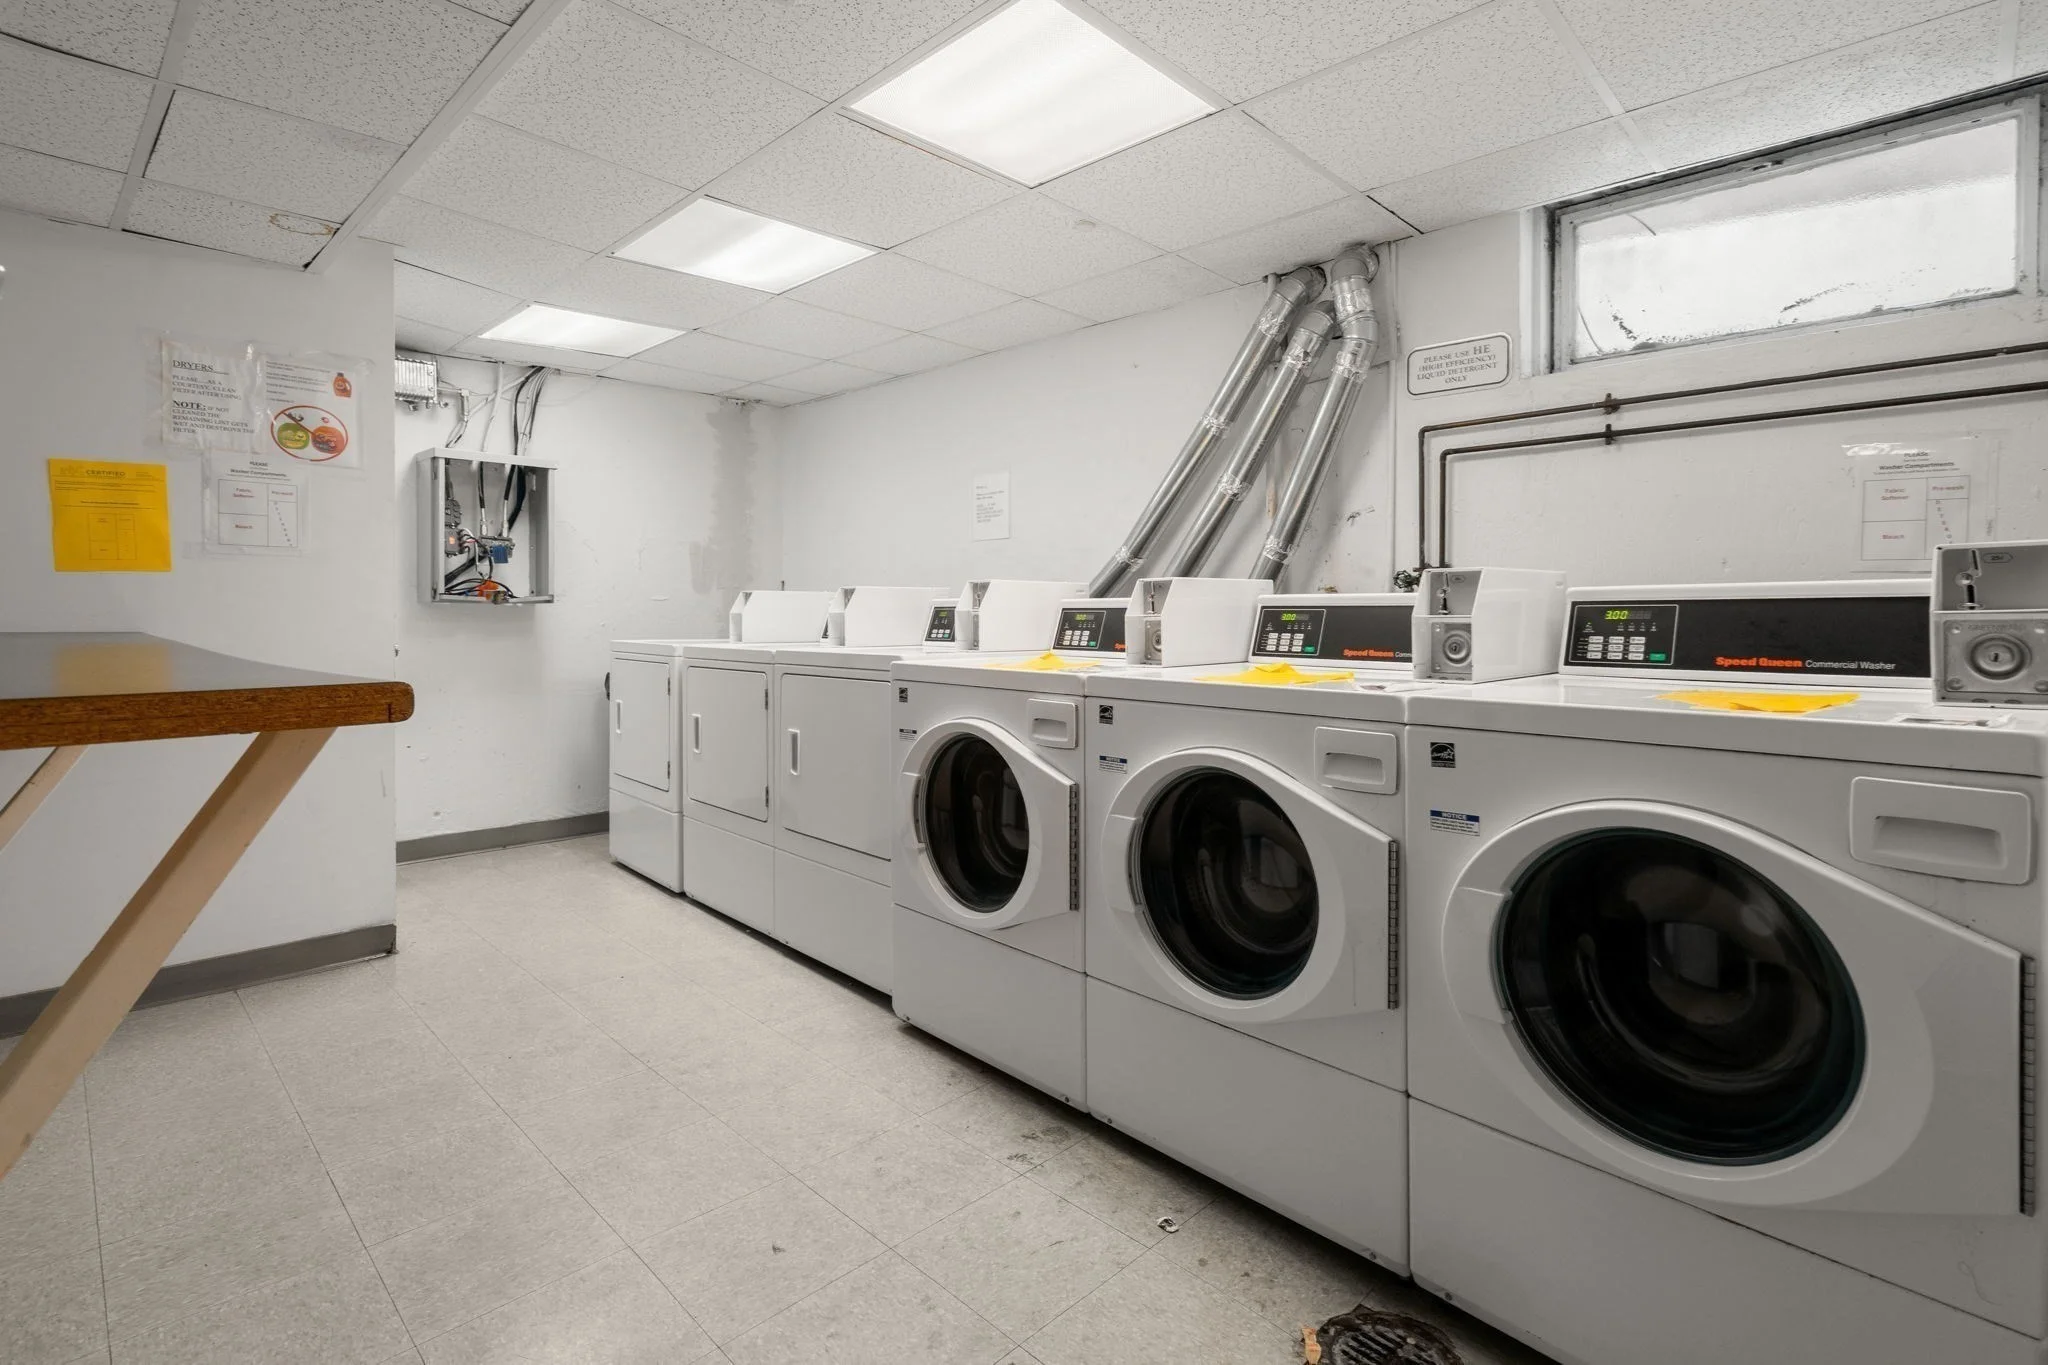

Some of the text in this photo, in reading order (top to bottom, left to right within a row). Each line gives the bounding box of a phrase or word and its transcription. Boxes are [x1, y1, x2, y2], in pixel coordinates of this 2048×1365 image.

[1424, 354, 1452, 363] PLEASE
[1473, 344, 1491, 355] HE
[173, 360, 214, 372] DRYERS
[1417, 361, 1497, 381] LIQUID DETERGENT
[1445, 375, 1467, 384] ONLY
[197, 390, 219, 398] AFTER
[172, 400, 206, 410] NOTE:
[172, 409, 206, 417] CLEANED
[172, 415, 212, 423] REMAINING
[1715, 656, 1896, 670] Speed Queen Commercial Washer
